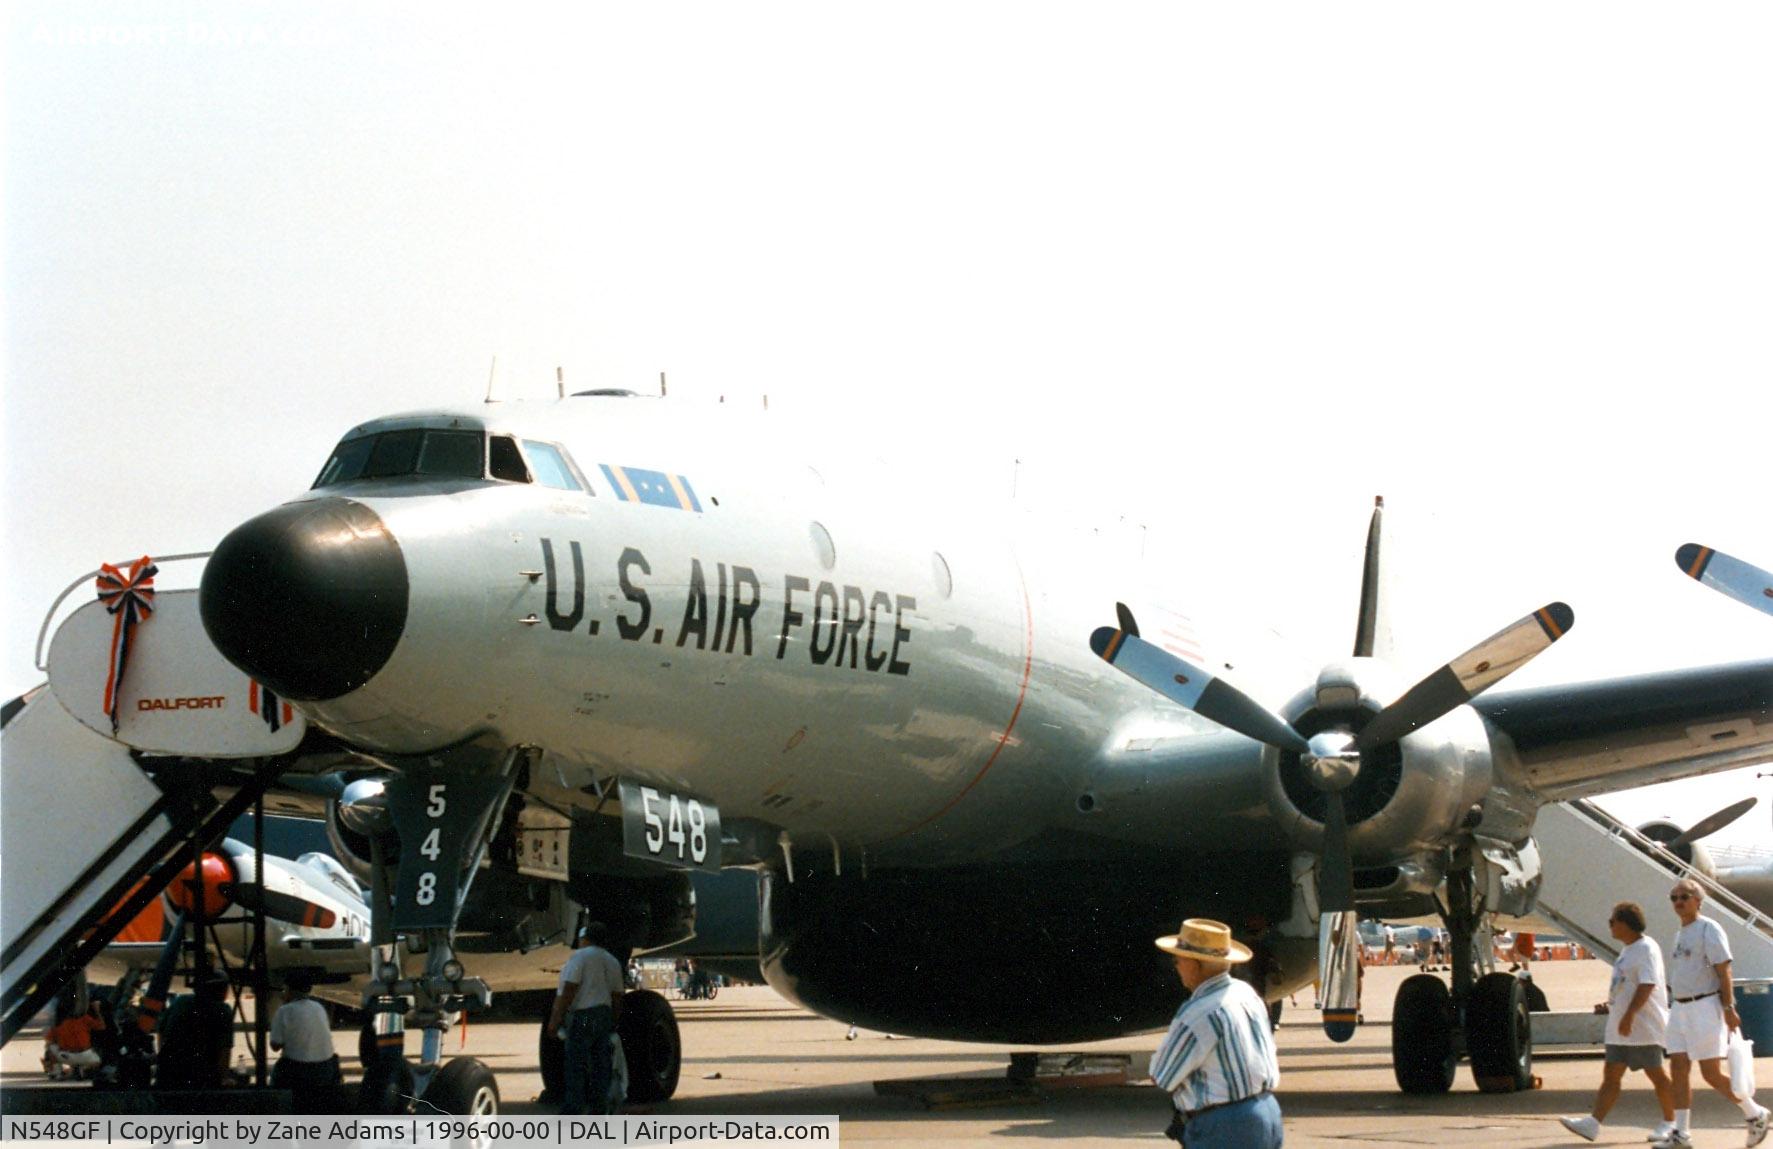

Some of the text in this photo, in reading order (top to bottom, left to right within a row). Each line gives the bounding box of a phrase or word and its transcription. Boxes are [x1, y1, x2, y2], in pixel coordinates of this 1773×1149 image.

[540, 537, 916, 676] U.S. AIR FORCE
[137, 696, 225, 712] DALFORT
[640, 786, 707, 863] 548
